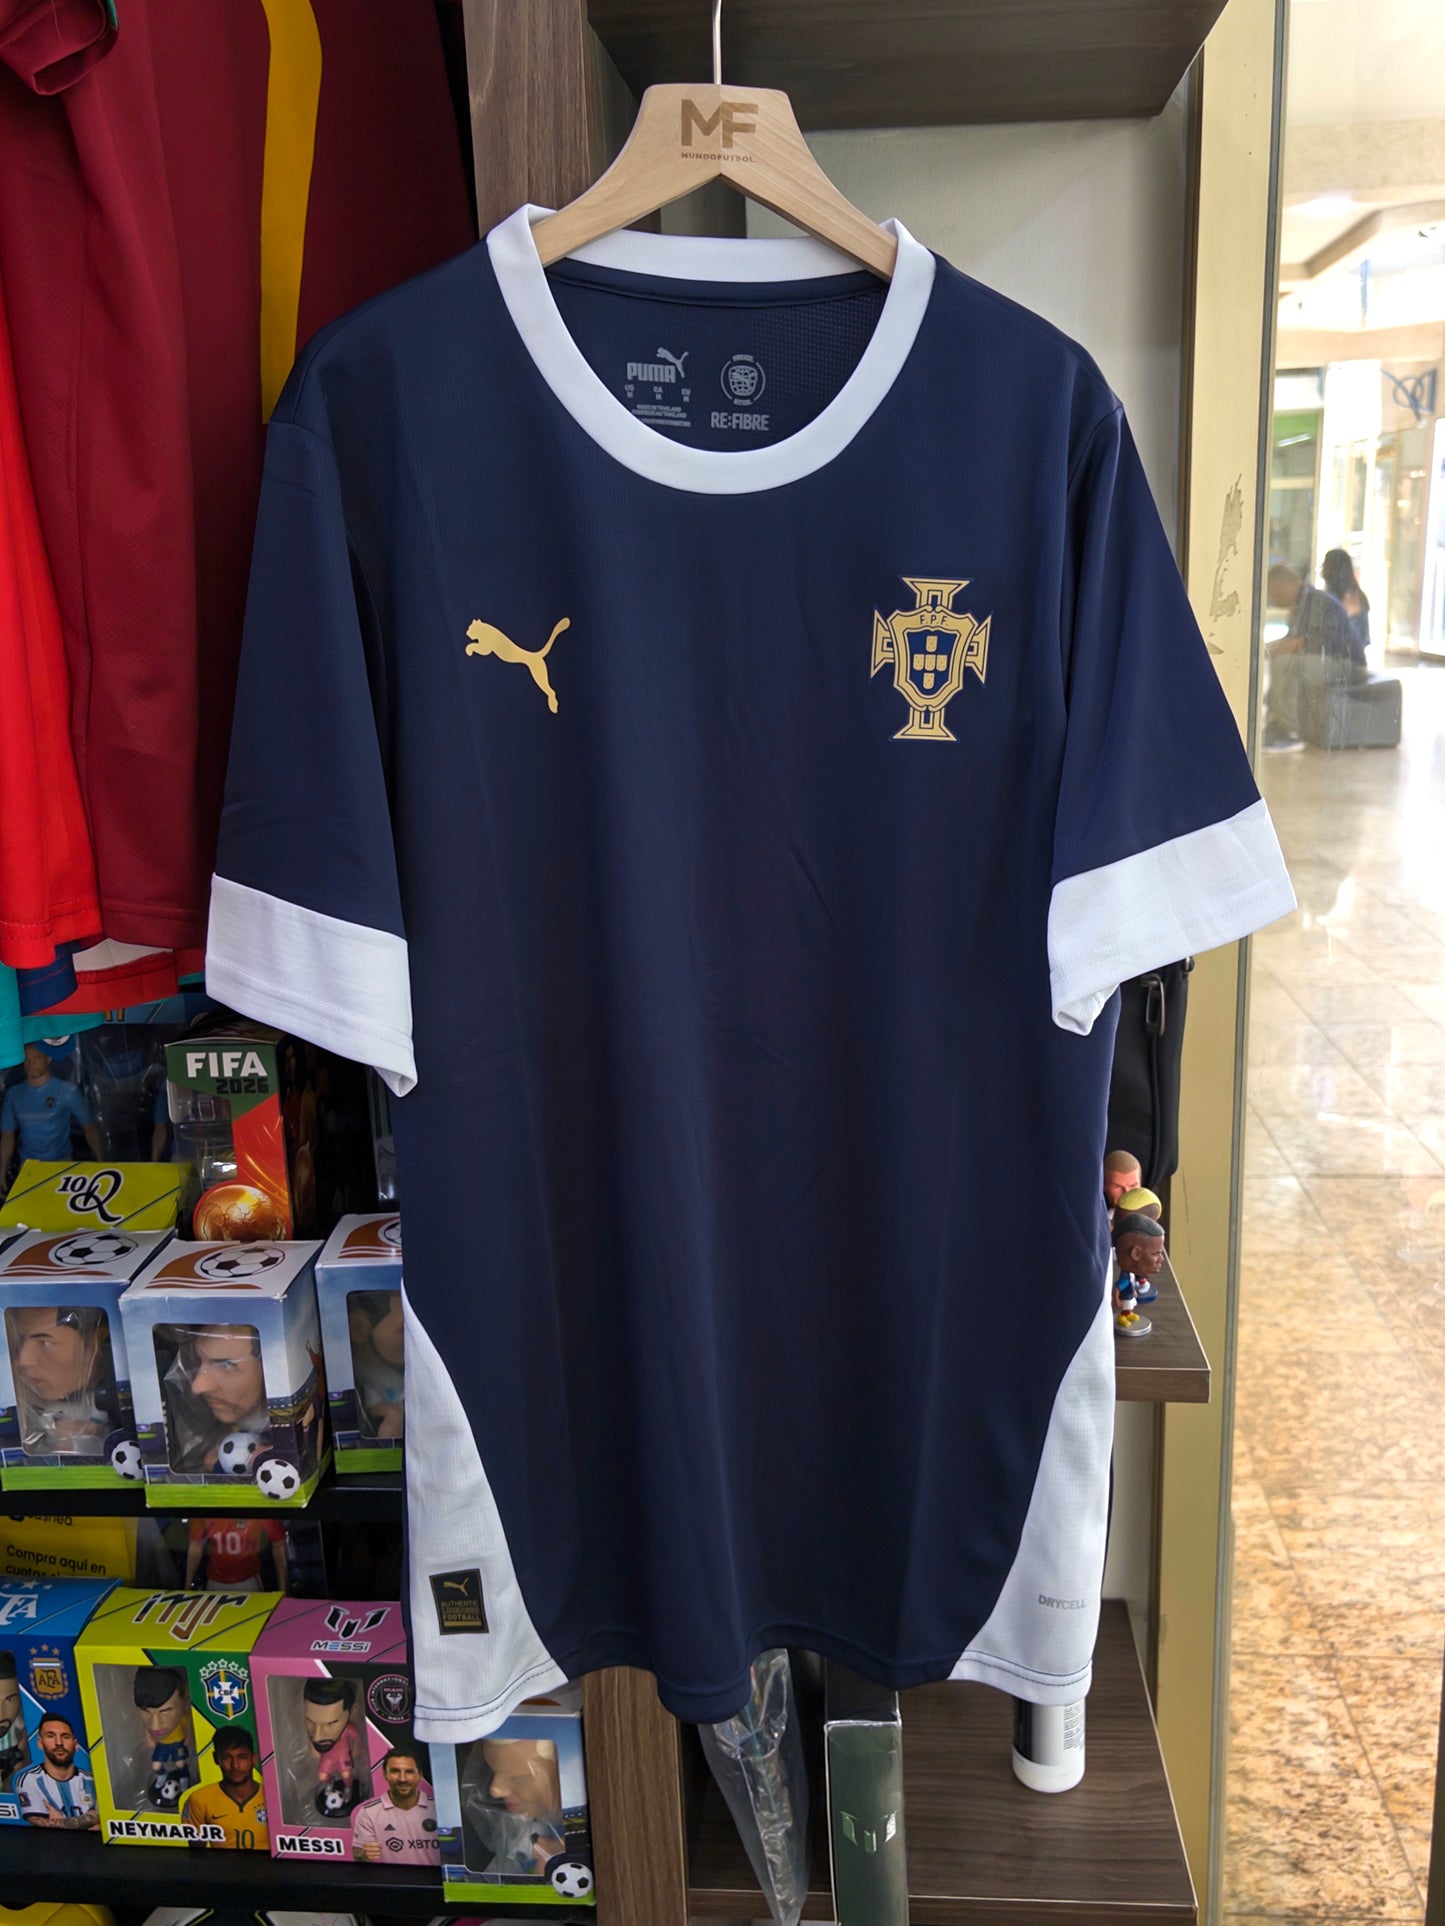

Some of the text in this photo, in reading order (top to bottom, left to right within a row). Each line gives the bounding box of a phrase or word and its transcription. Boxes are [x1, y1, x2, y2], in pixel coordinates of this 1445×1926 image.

[681, 99, 758, 148] MF
[627, 362, 676, 383] PUMA
[711, 412, 770, 431] RE:FIBRE
[186, 1052, 268, 1077] FIFA
[216, 1079, 269, 1094] 2026
[213, 1531, 241, 1554] 10
[6, 1545, 106, 1575] Compra aquí en
[1039, 1594, 1086, 1610] DRYCELL
[109, 1821, 223, 1840] NEYMAR JR
[233, 1828, 255, 1850] 10
[278, 1836, 343, 1854] MESSI
[408, 1838, 440, 1850] XBTO
